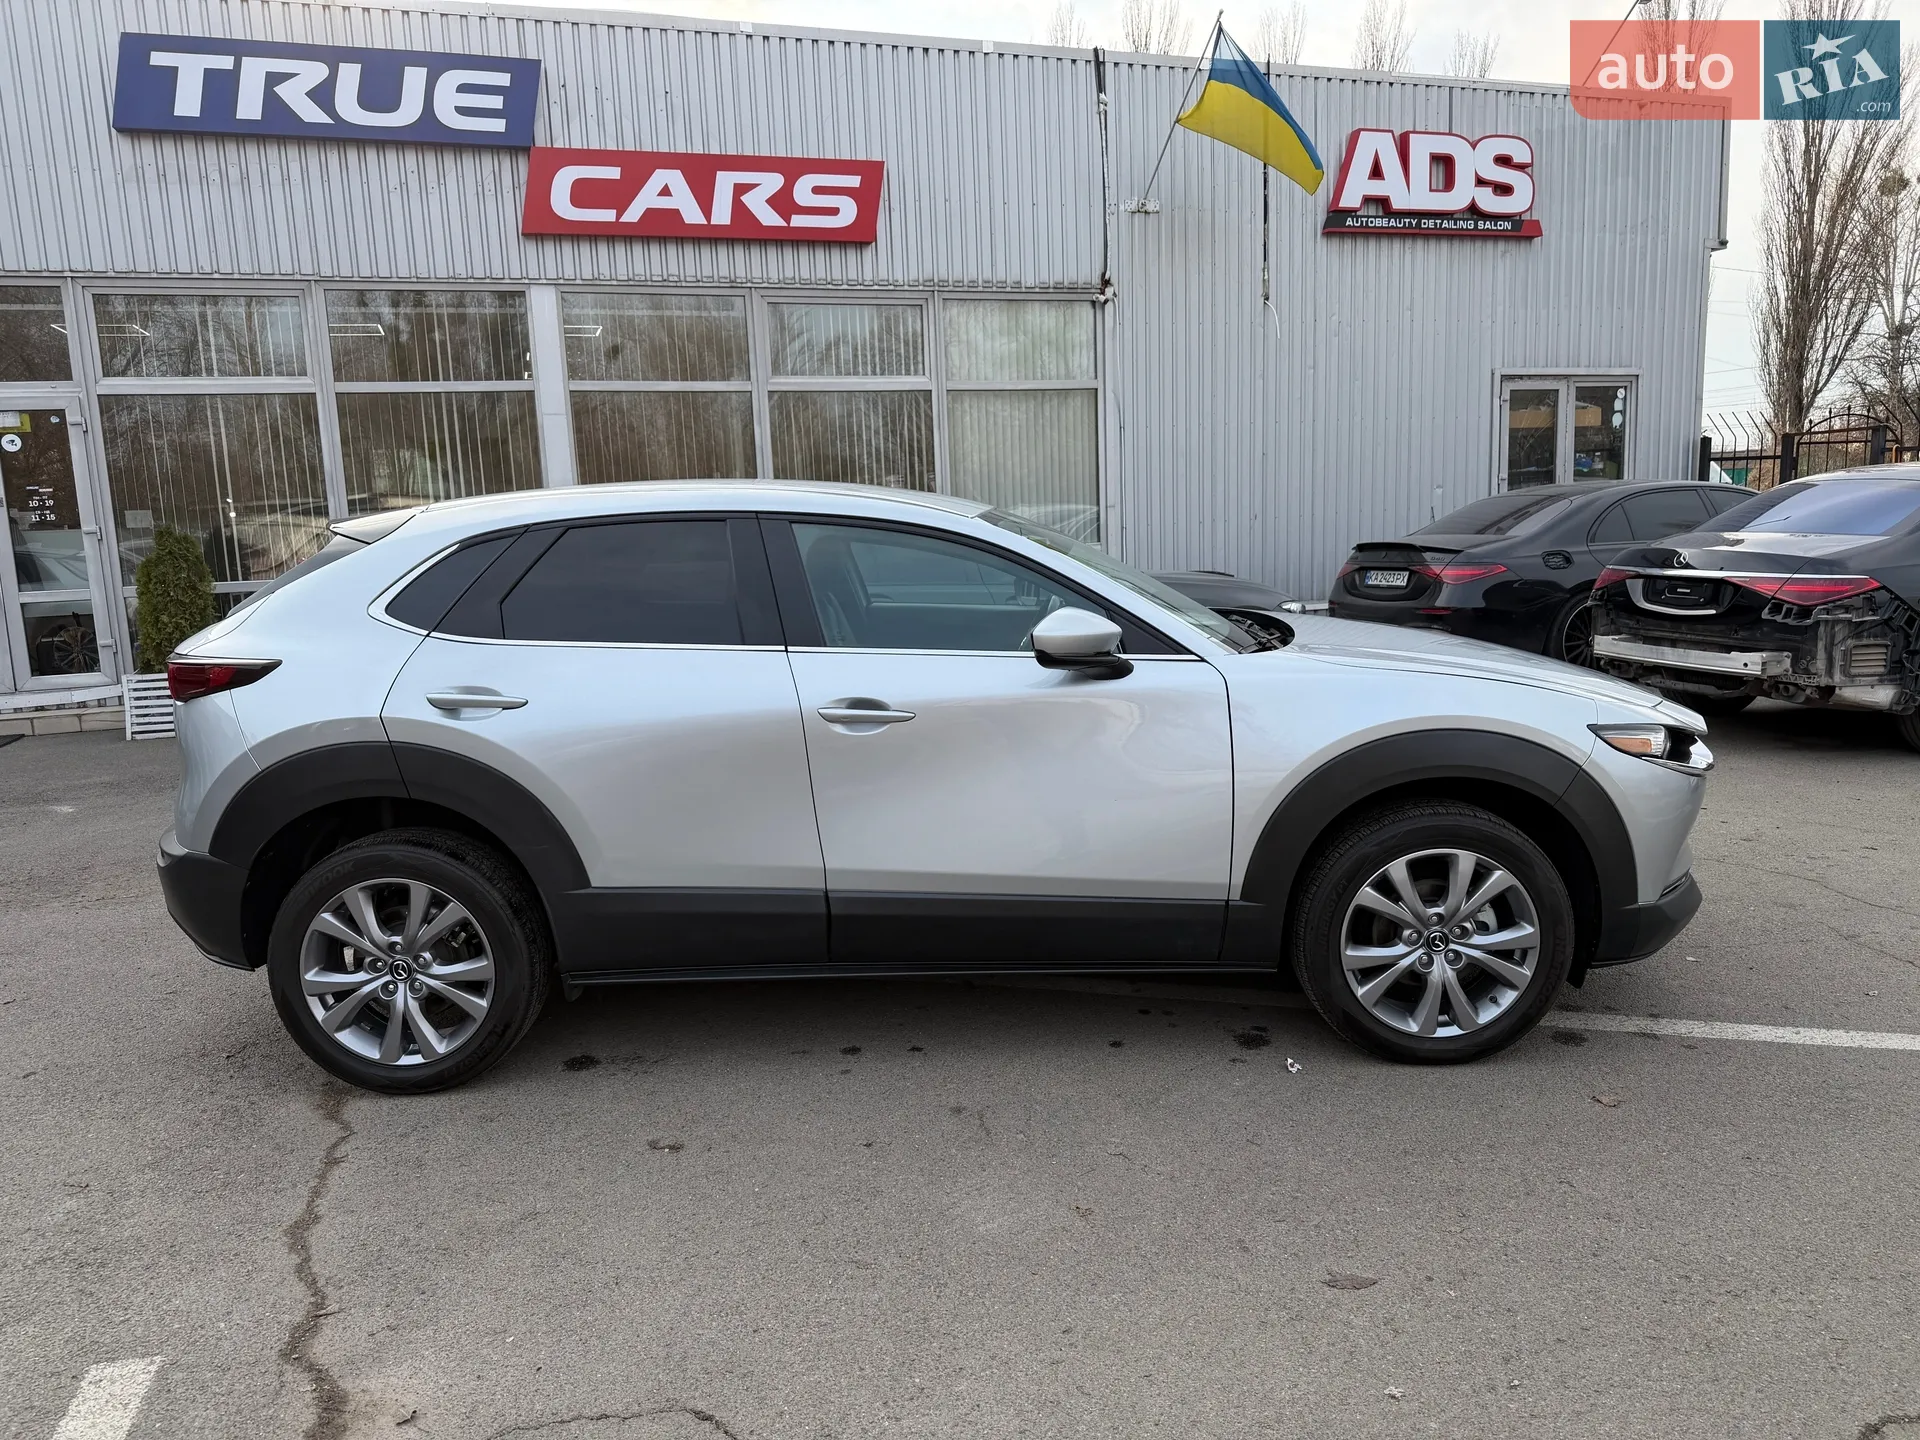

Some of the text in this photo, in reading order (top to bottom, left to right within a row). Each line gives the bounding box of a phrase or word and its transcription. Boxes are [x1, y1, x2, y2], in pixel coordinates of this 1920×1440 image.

[149, 51, 511, 133] TRUE
[550, 165, 862, 229] CARS
[1335, 129, 1535, 215] ADS
[1345, 217, 1512, 231] AUTOBEAUTY DETAILING SALON
